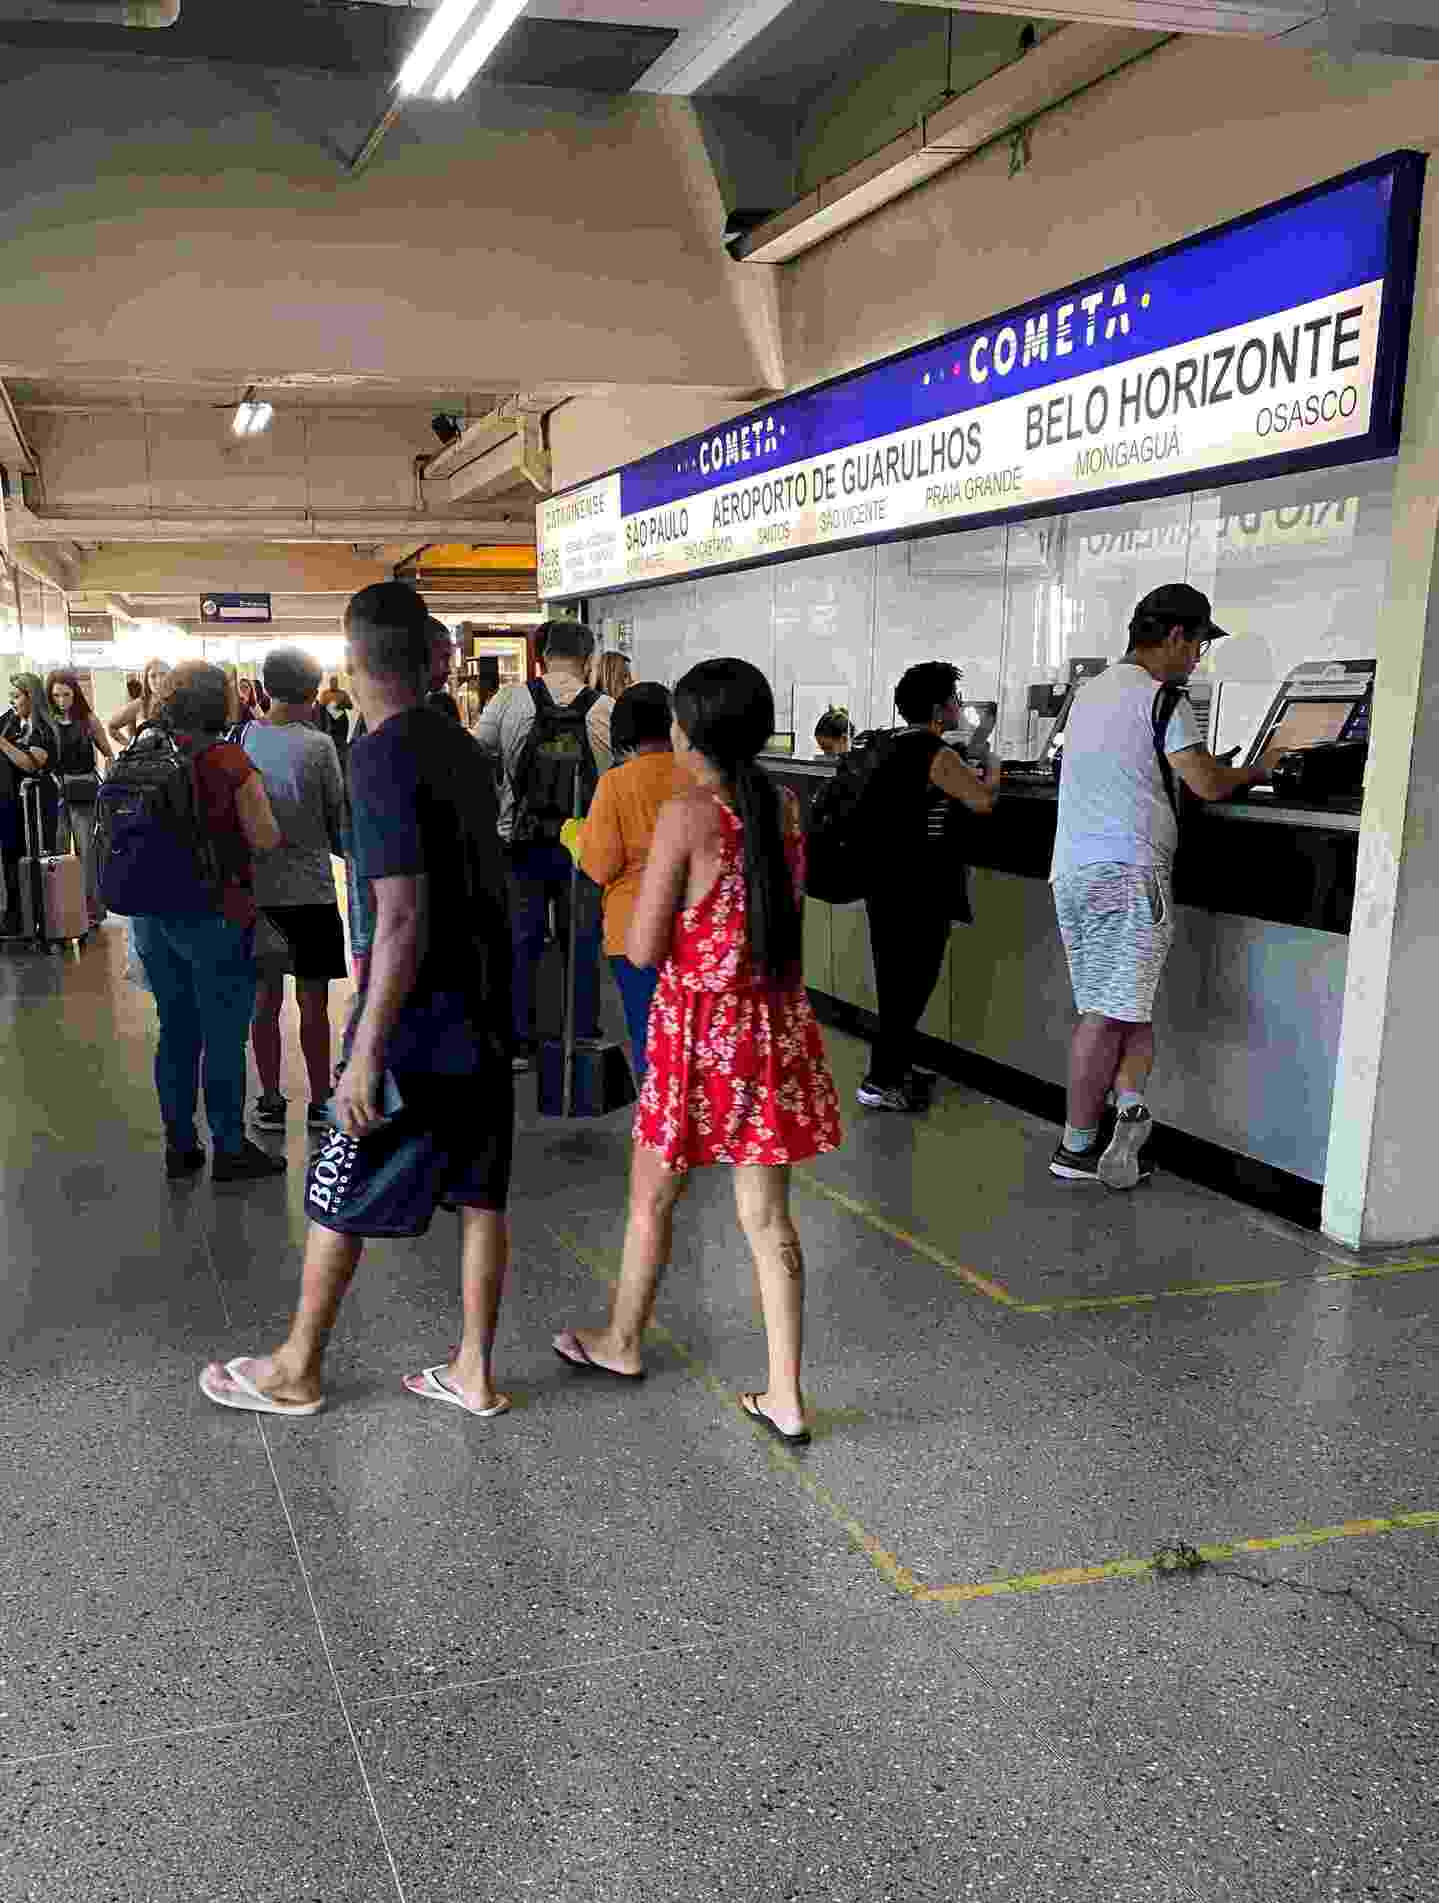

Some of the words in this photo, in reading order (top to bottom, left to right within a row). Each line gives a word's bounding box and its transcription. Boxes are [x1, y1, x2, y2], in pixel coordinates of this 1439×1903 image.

[968, 283, 1130, 385] COMETA
[625, 516, 647, 551] SÃO
[650, 508, 688, 545] PAULO
[712, 471, 808, 528] AEROPORTO
[813, 463, 836, 503] DE
[842, 420, 982, 495] GUARULHOS
[1025, 384, 1109, 451] BELO
[1119, 304, 1364, 427] HORIZONTE
[699, 415, 778, 475] COMETA
[842, 498, 887, 528] VICENTE
[925, 484, 962, 506] PRAIA
[963, 465, 1024, 500] GRANDE
[1074, 424, 1182, 479] MONGAGUÁ
[1256, 385, 1358, 437] OSASCO
[309, 1132, 347, 1212] BOSS
